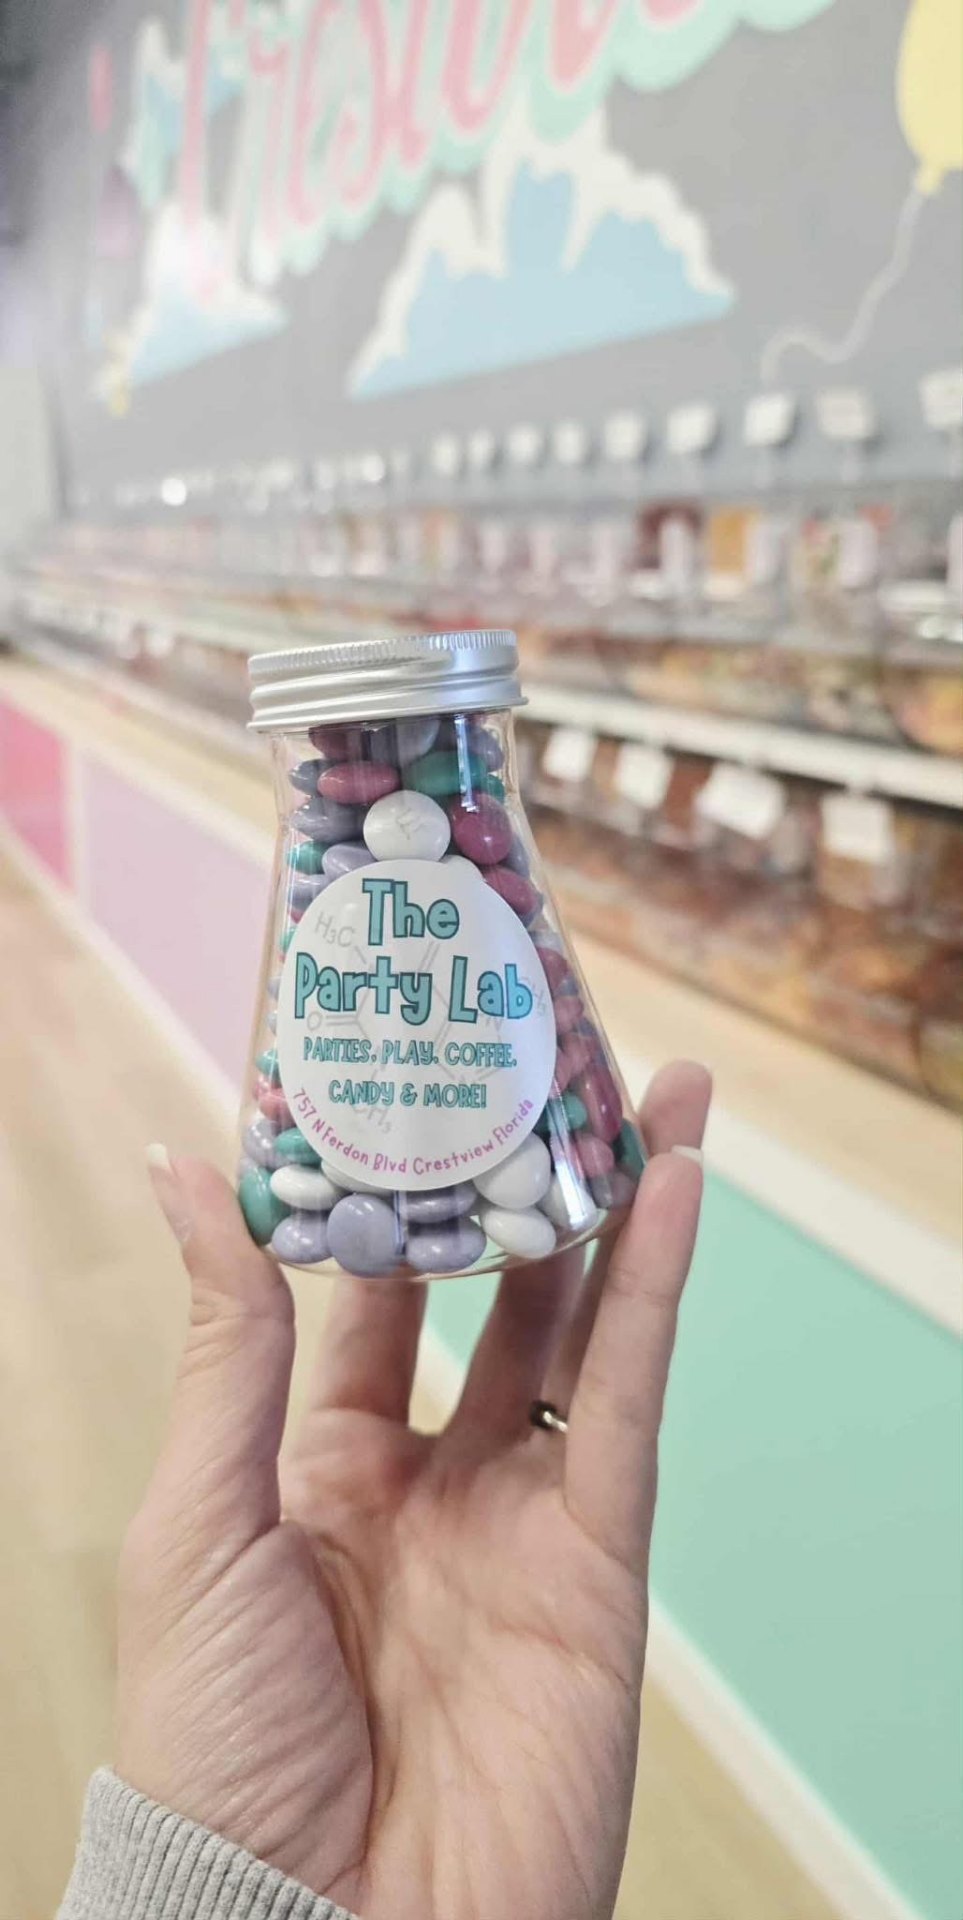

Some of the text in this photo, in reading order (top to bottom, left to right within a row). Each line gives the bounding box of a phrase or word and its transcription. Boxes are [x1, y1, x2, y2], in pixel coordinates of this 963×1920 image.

[362, 878, 460, 946] The
[294, 951, 433, 1026] Party
[448, 955, 533, 1024] Lab
[328, 1079, 487, 1109] CANDY & MORE!
[293, 1087, 534, 1175] 757 N Ferdon Blvd Crestview Florida
